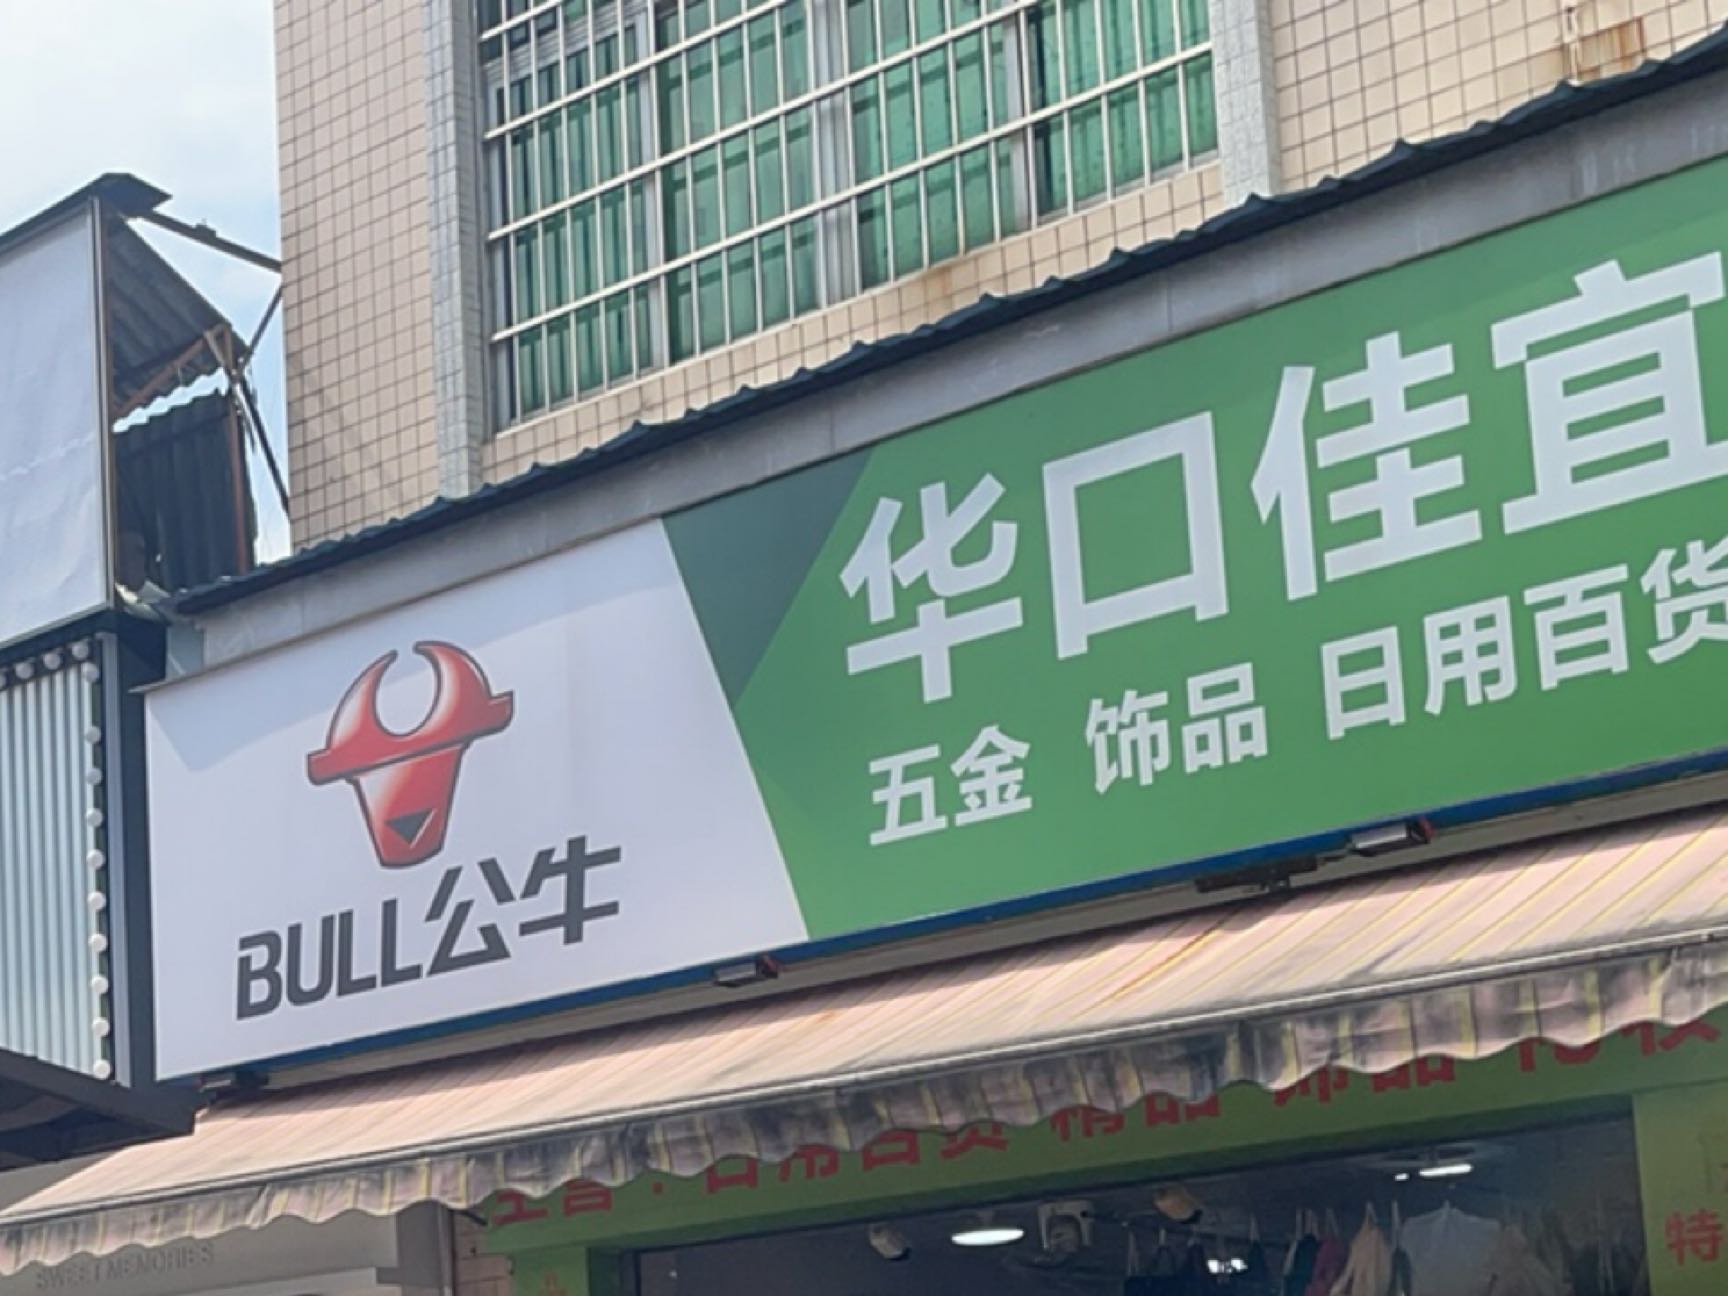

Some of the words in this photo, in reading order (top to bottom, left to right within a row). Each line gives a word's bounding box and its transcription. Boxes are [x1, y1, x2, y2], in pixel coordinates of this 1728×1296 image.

[839, 252, 1728, 703] 华口佳宜
[869, 724, 1032, 846] 五金
[1084, 661, 1269, 796] 饰品
[1318, 537, 1728, 739] 日用百货
